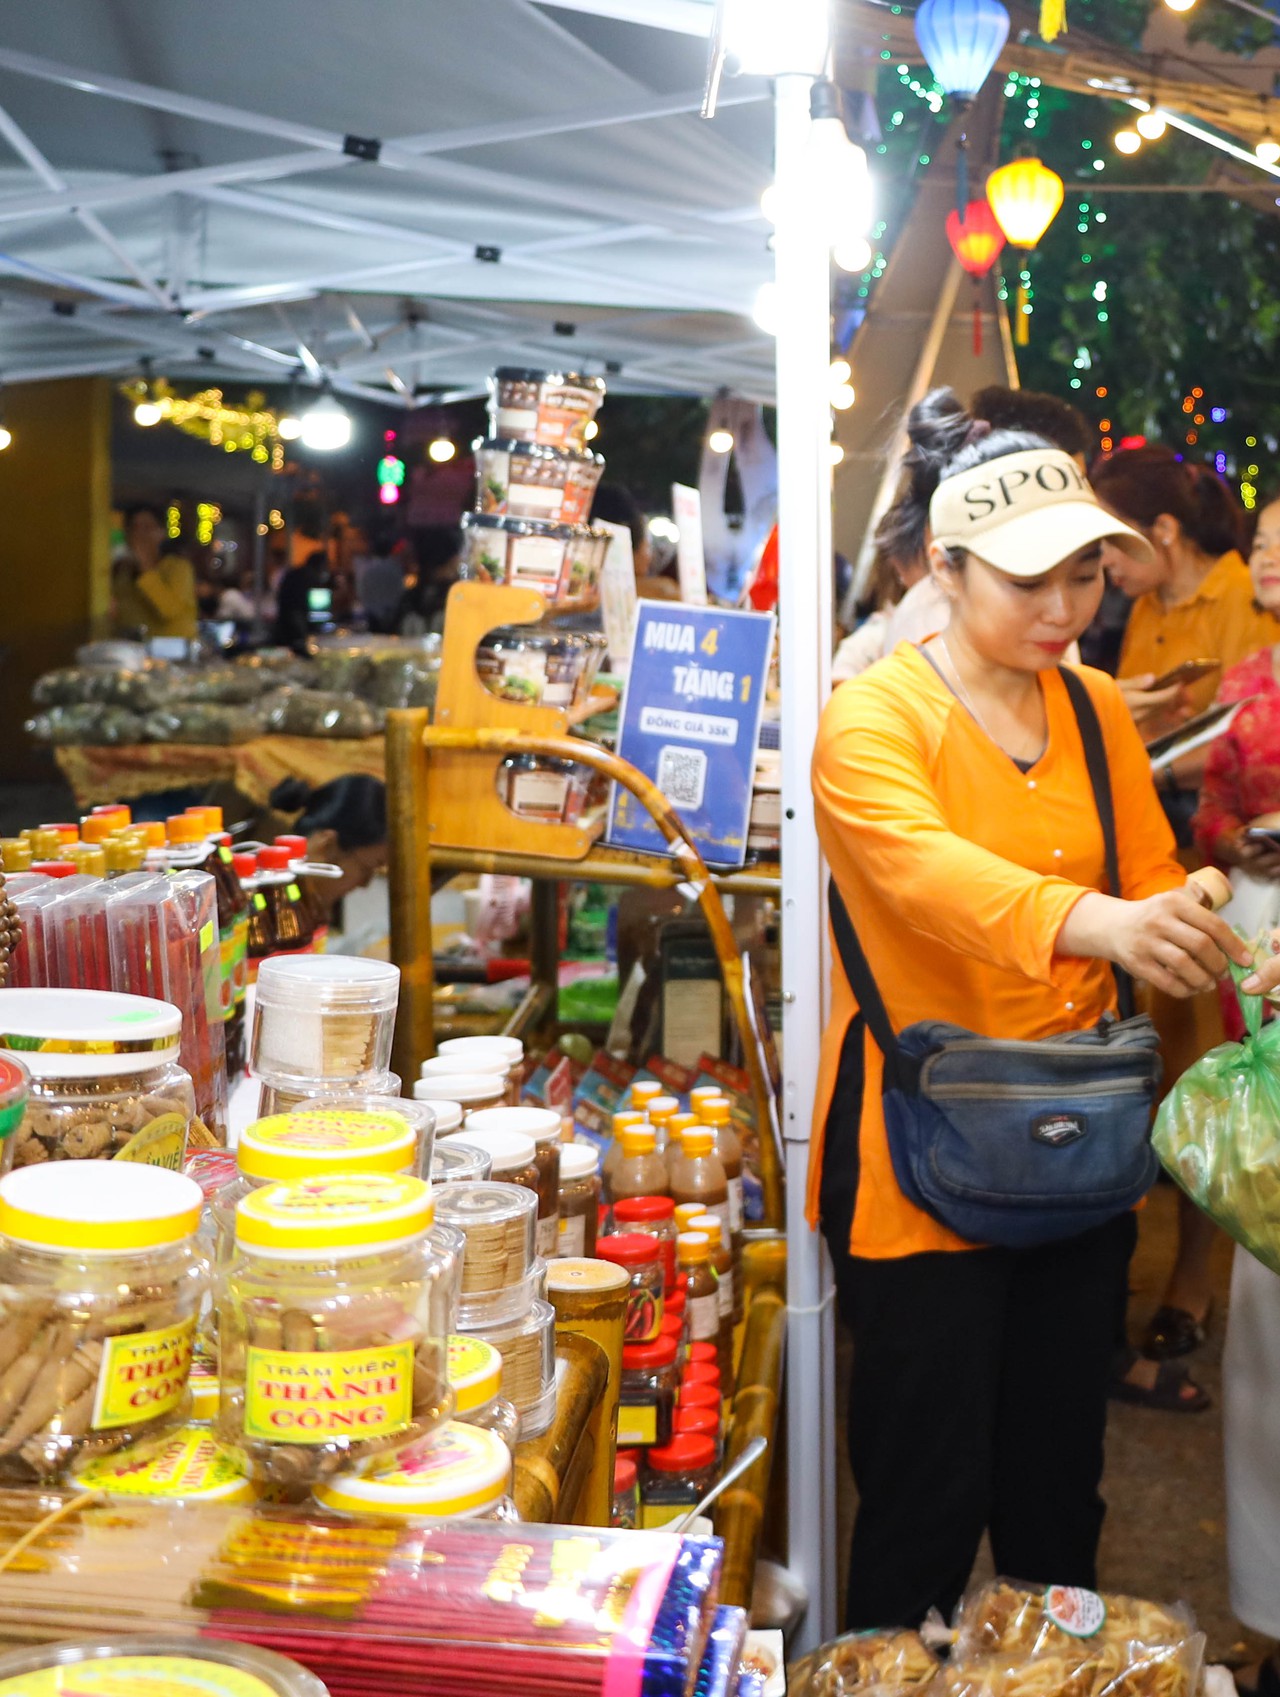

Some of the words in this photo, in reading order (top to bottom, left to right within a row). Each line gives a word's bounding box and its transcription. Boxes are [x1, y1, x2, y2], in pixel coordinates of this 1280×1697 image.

[643, 621, 696, 654] MUA
[700, 628, 719, 657] 4
[672, 660, 735, 702] TẶNG
[739, 675, 752, 703] 1
[269, 1406, 387, 1429] CÔNG
